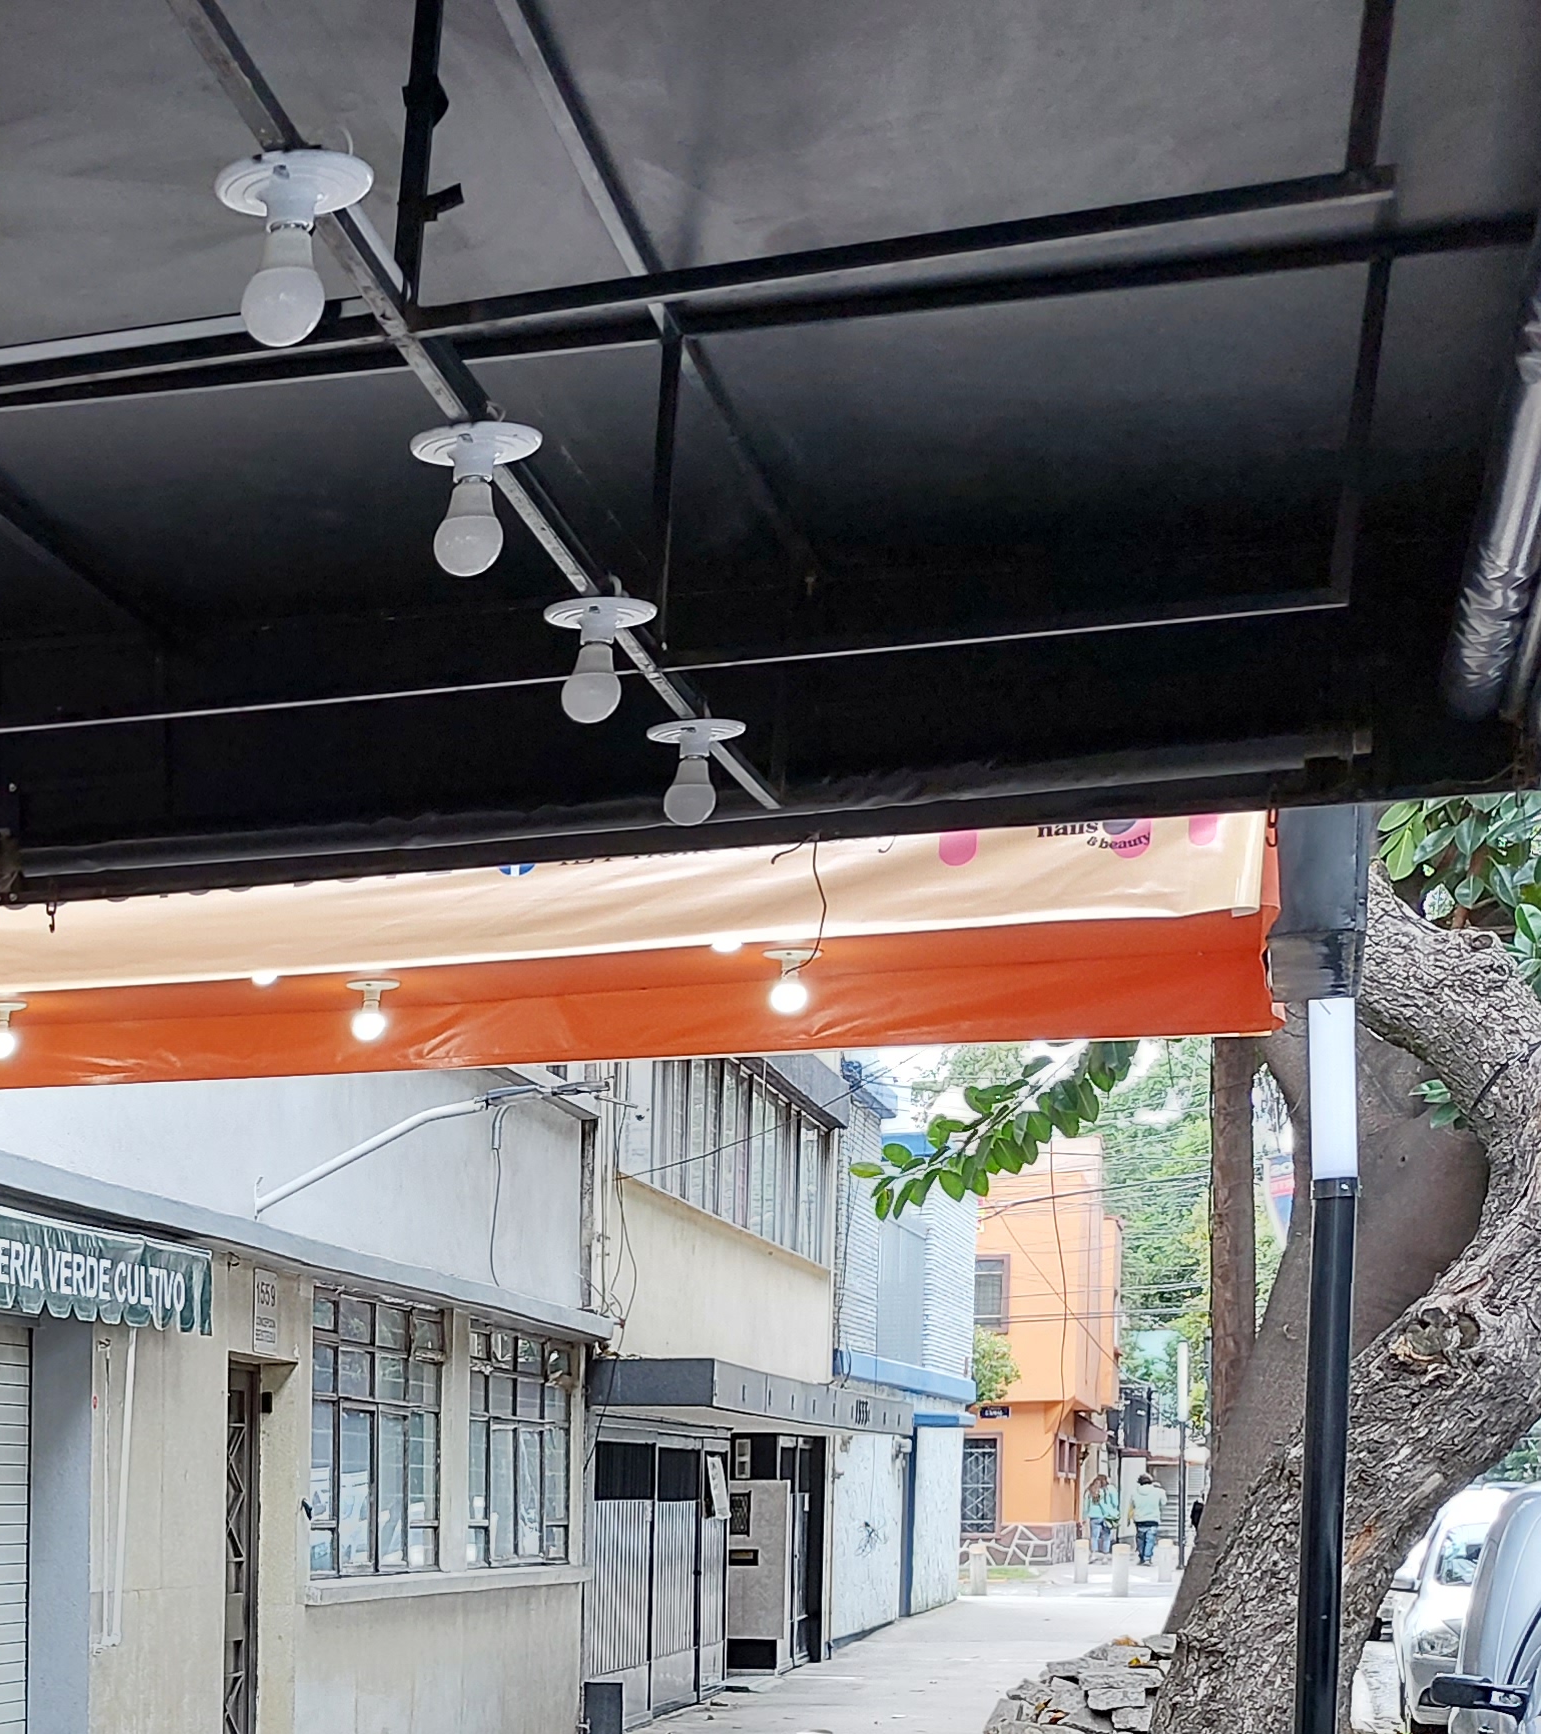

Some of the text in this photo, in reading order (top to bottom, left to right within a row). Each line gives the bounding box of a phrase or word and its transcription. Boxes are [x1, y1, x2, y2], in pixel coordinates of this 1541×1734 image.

[46, 1250, 112, 1301] VERDE
[114, 1262, 186, 1312] CULTIVO
[257, 1282, 276, 1307] 1559
